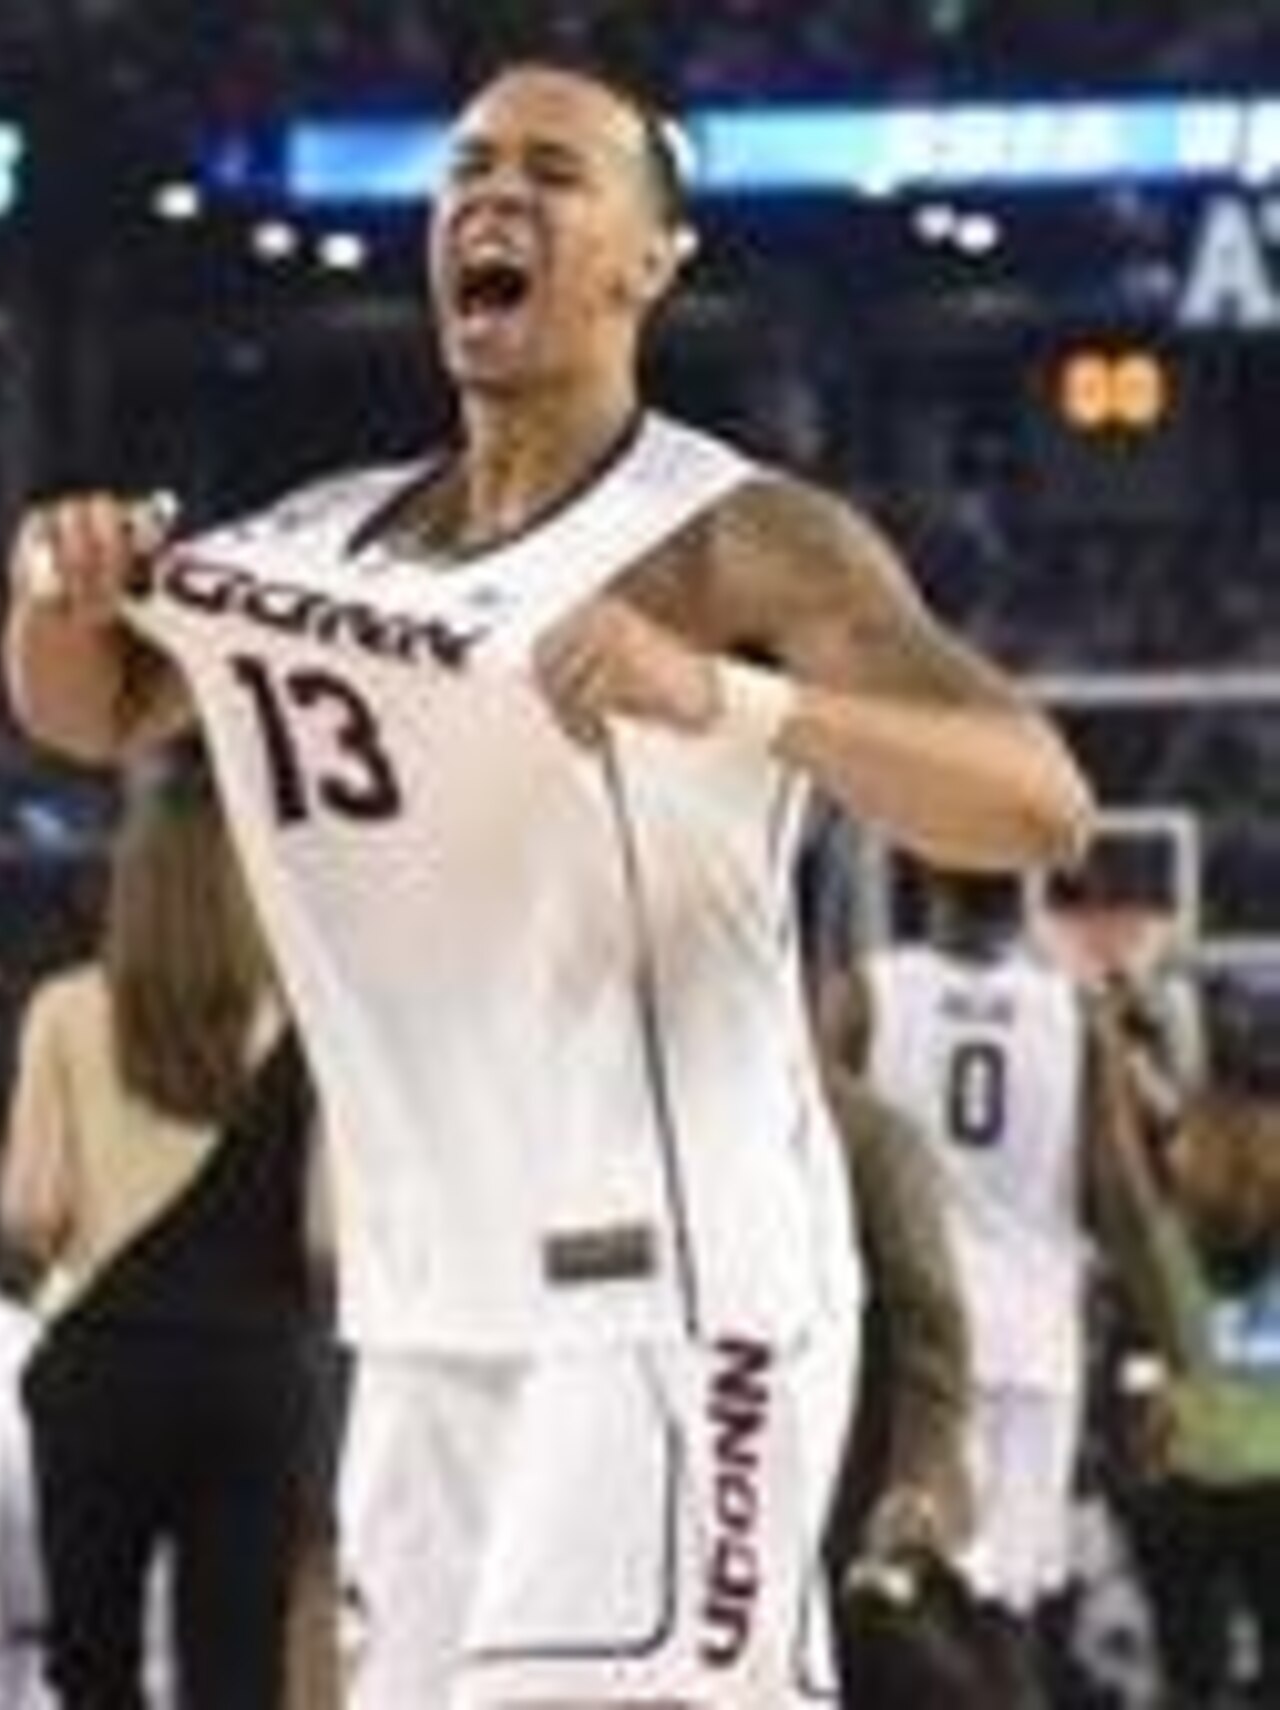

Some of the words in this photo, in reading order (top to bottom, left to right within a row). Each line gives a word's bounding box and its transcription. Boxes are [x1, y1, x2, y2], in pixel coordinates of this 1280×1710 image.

[232, 654, 402, 826] 13
[948, 1040, 1008, 1150] 0
[699, 1336, 775, 1668] UCONN
